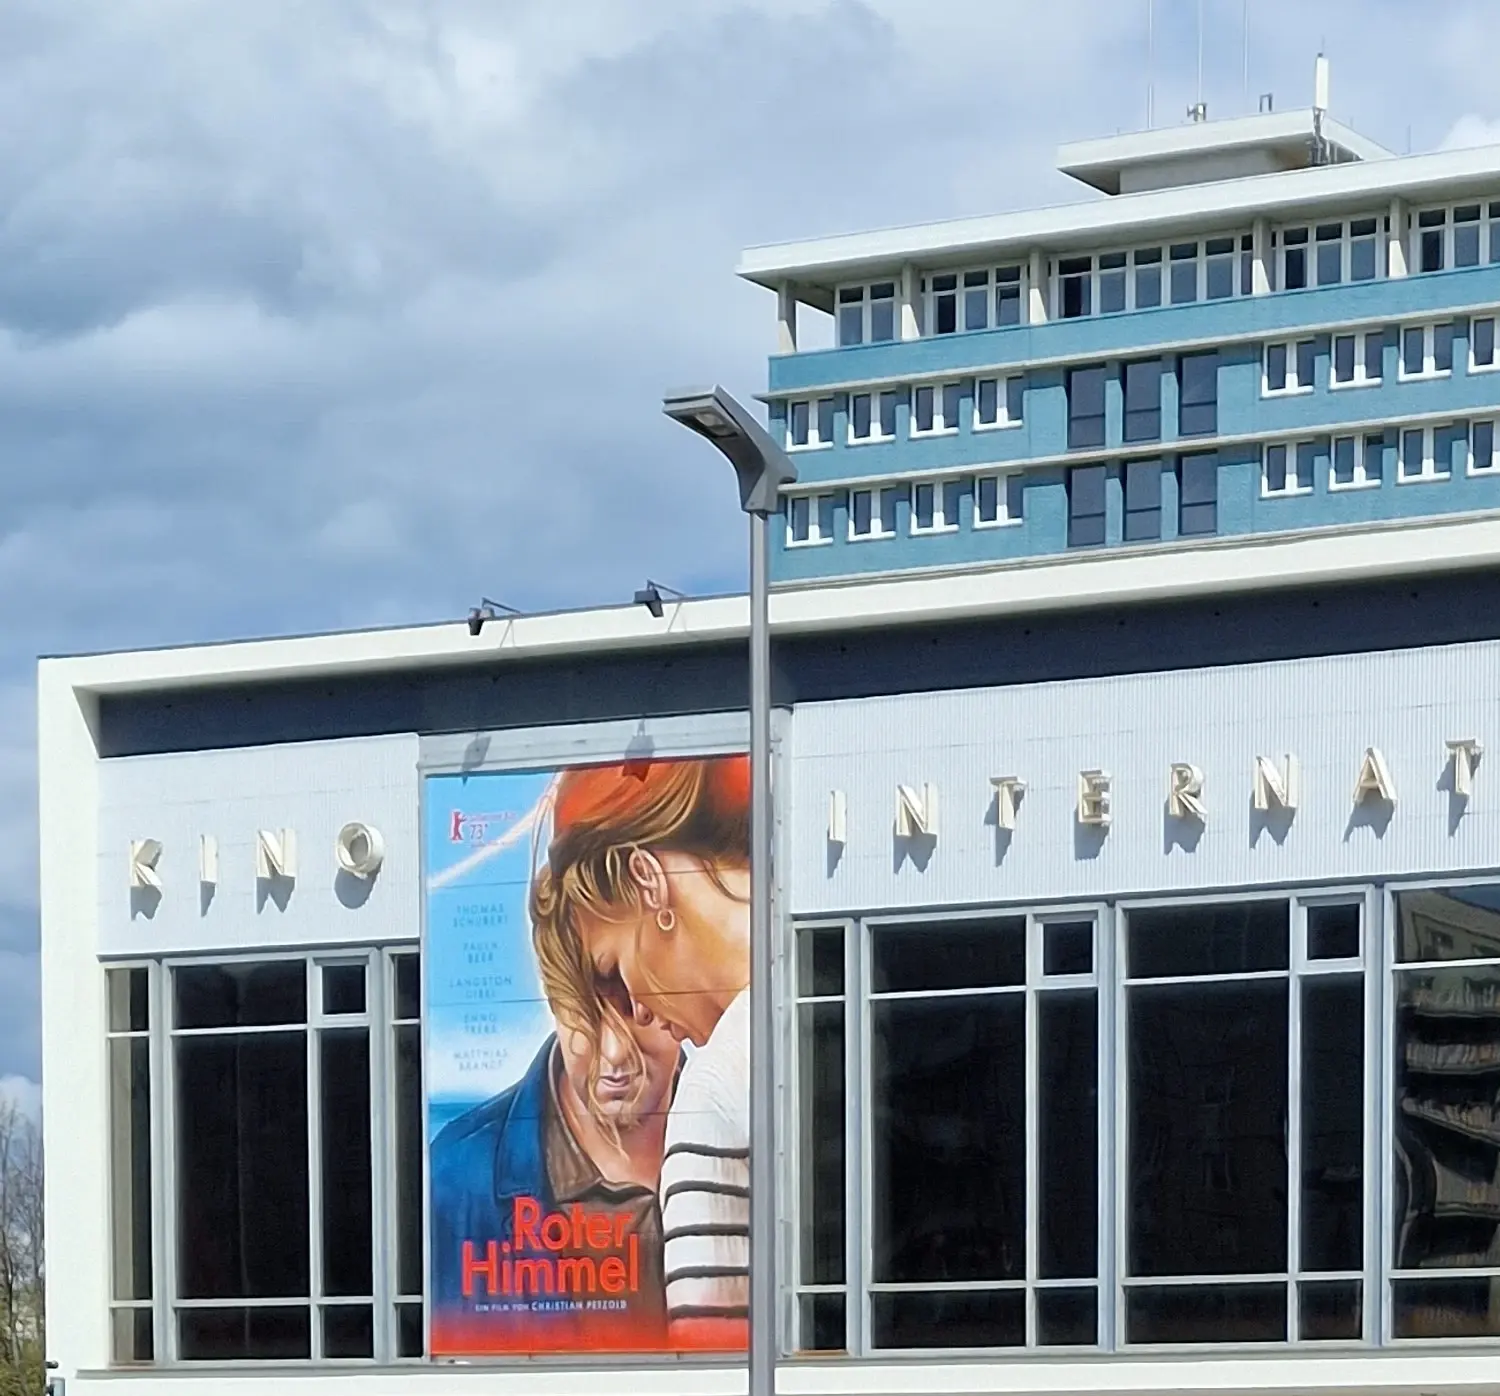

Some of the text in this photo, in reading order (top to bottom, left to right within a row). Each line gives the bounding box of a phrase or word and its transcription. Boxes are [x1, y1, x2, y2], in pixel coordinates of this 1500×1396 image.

[128, 821, 384, 887] KINO
[514, 1196, 633, 1250] Roter
[462, 1233, 638, 1295] Himmel
[531, 1300, 583, 1312] CHRISTIAN
[586, 1299, 628, 1311] PETZOLD
